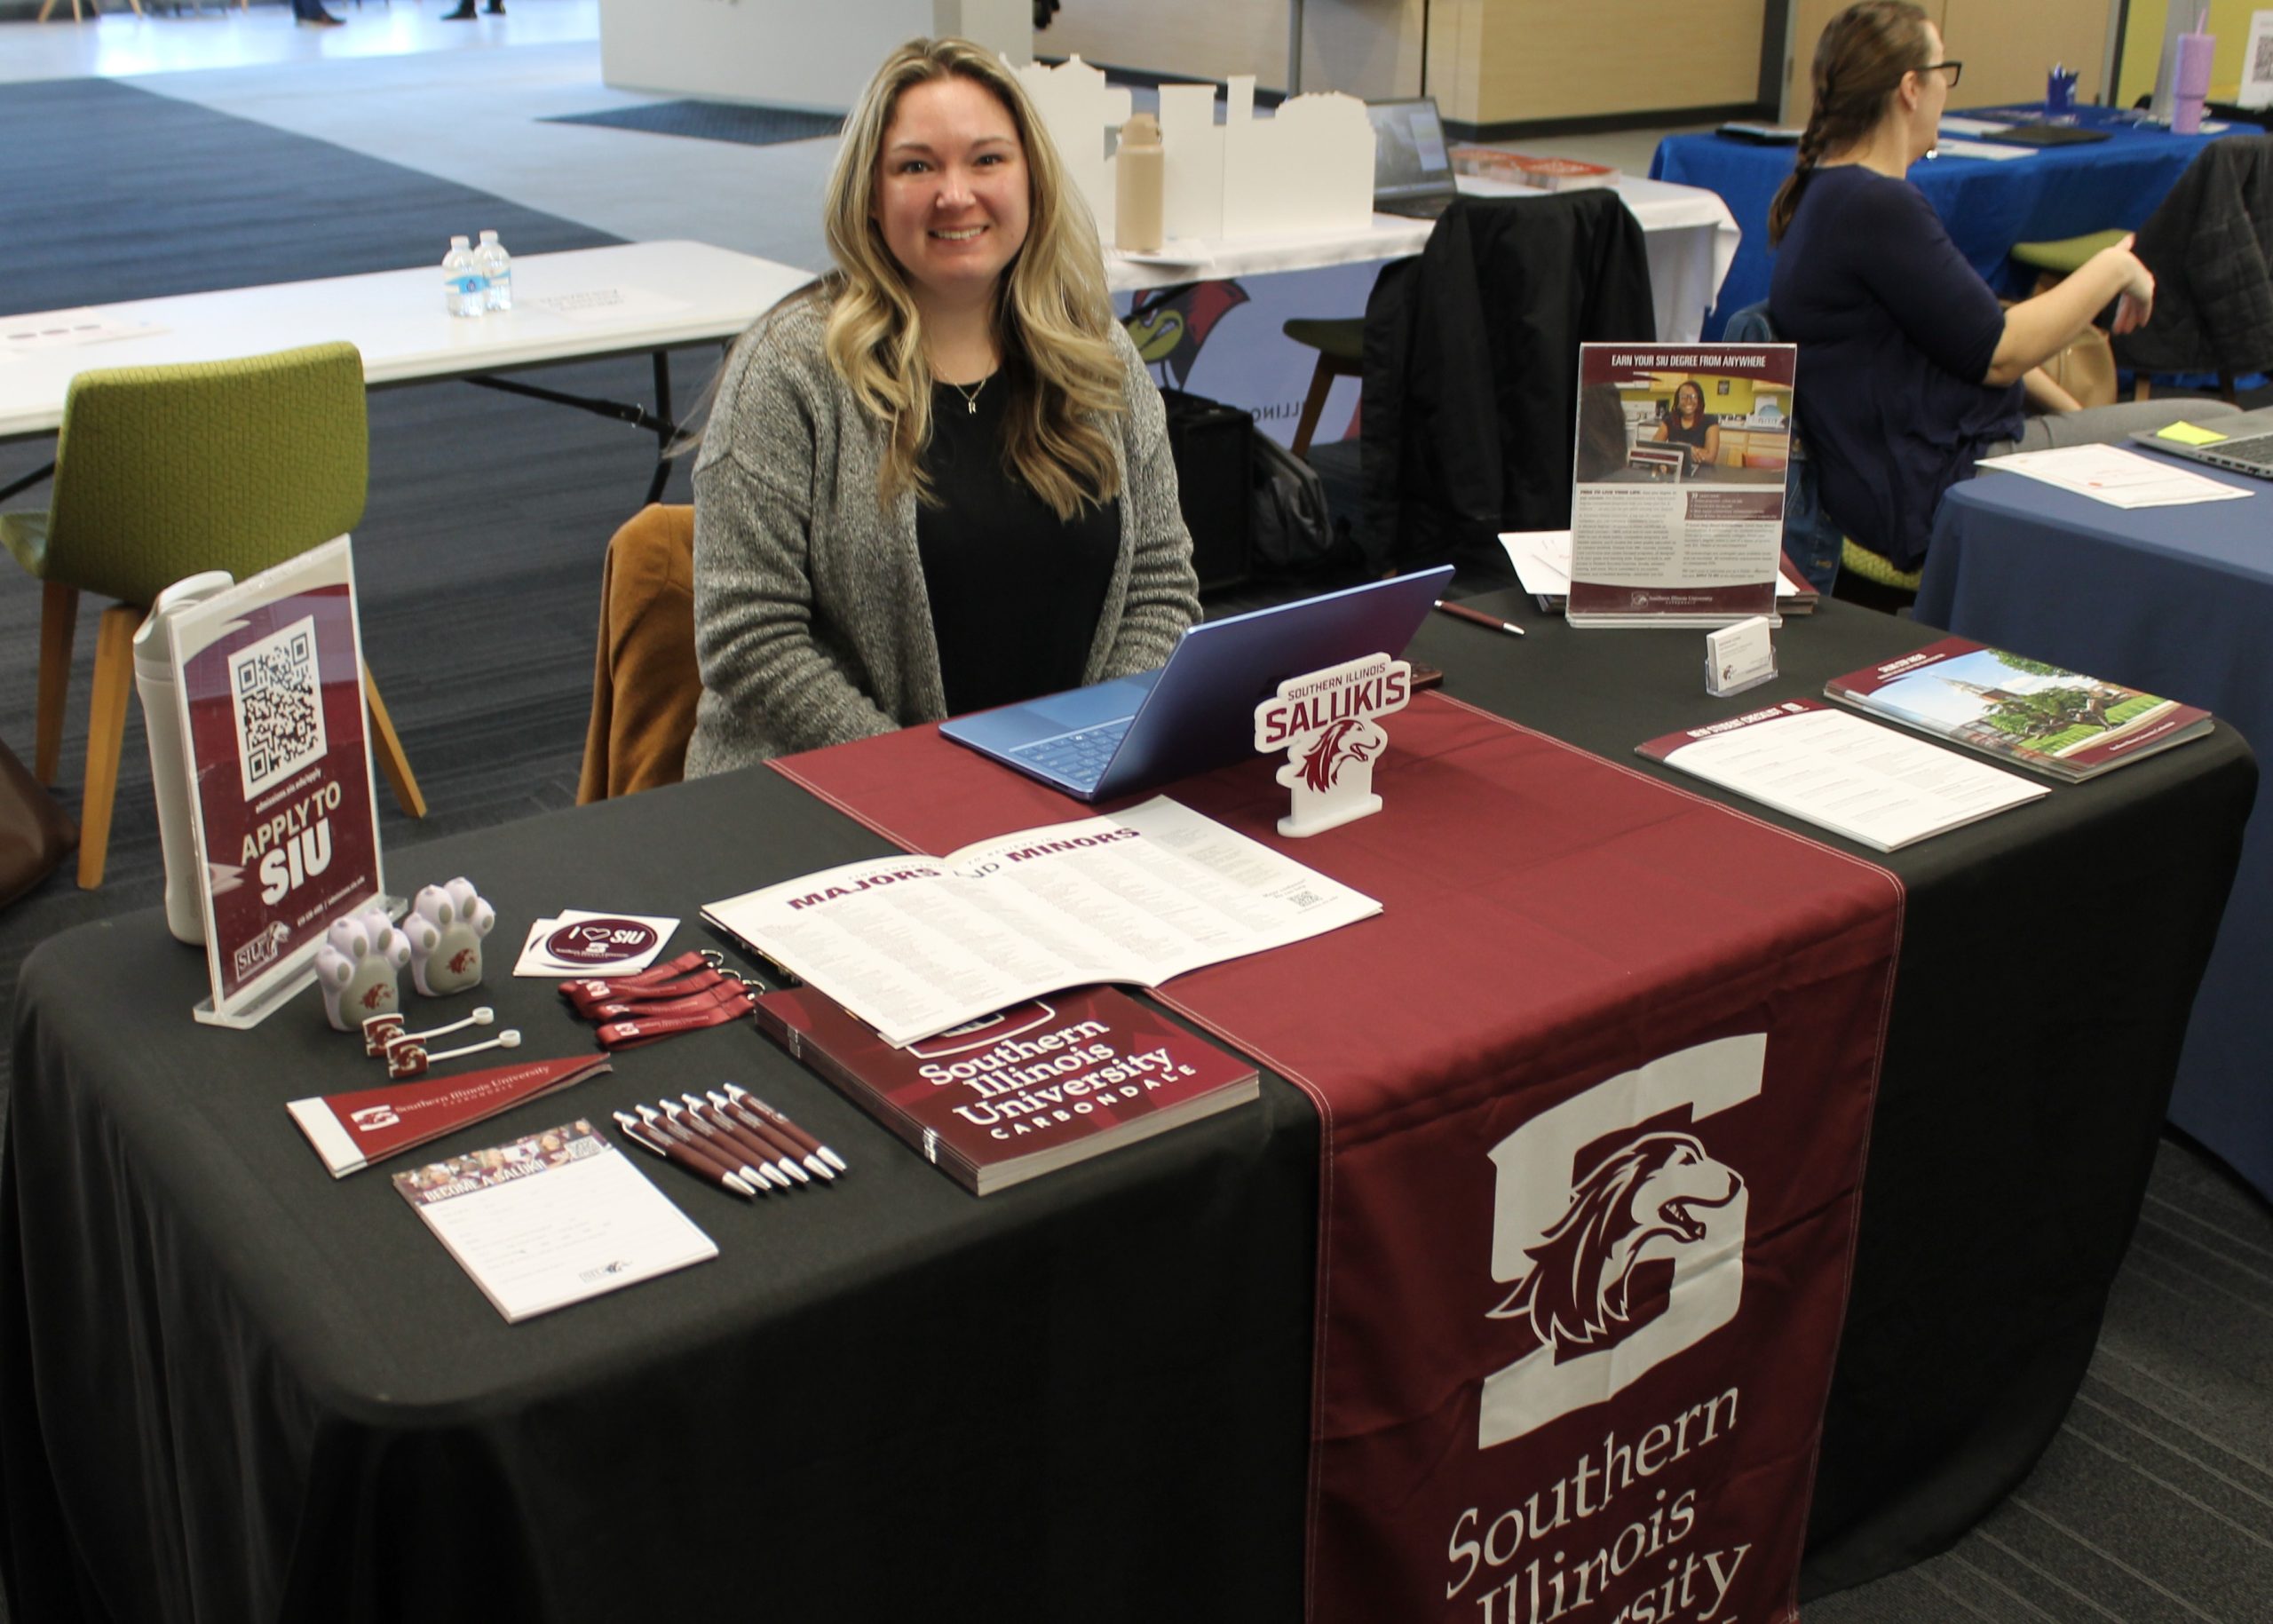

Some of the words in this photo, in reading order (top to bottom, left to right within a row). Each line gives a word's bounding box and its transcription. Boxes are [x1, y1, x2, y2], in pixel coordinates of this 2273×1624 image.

[1612, 354, 1632, 367] EARN
[1634, 354, 1654, 367] YOUR
[1656, 355, 1668, 367] SIU
[1670, 355, 1698, 368] DEGREE
[1699, 355, 1722, 368] FROM
[1723, 355, 1766, 368] ANYWHERE
[1266, 670, 1406, 743] SALUKIS
[1288, 677, 1342, 701] SOUTHERN
[1346, 663, 1386, 684] ILLINOIS
[242, 797, 310, 867] APPLY
[312, 780, 342, 818] TO
[259, 817, 332, 906] SIU
[787, 867, 942, 910] MAJORS
[1005, 827, 1141, 863] MINORS
[568, 925, 581, 939] I
[610, 929, 646, 945] SIU
[919, 1020, 1111, 1086] Southern
[953, 1047, 1175, 1126] University
[962, 1042, 1115, 1099] Illinois
[990, 1064, 1197, 1140] CARBONDALE
[424, 1177, 480, 1202] BECOME
[1446, 1386, 1739, 1599] Southern
